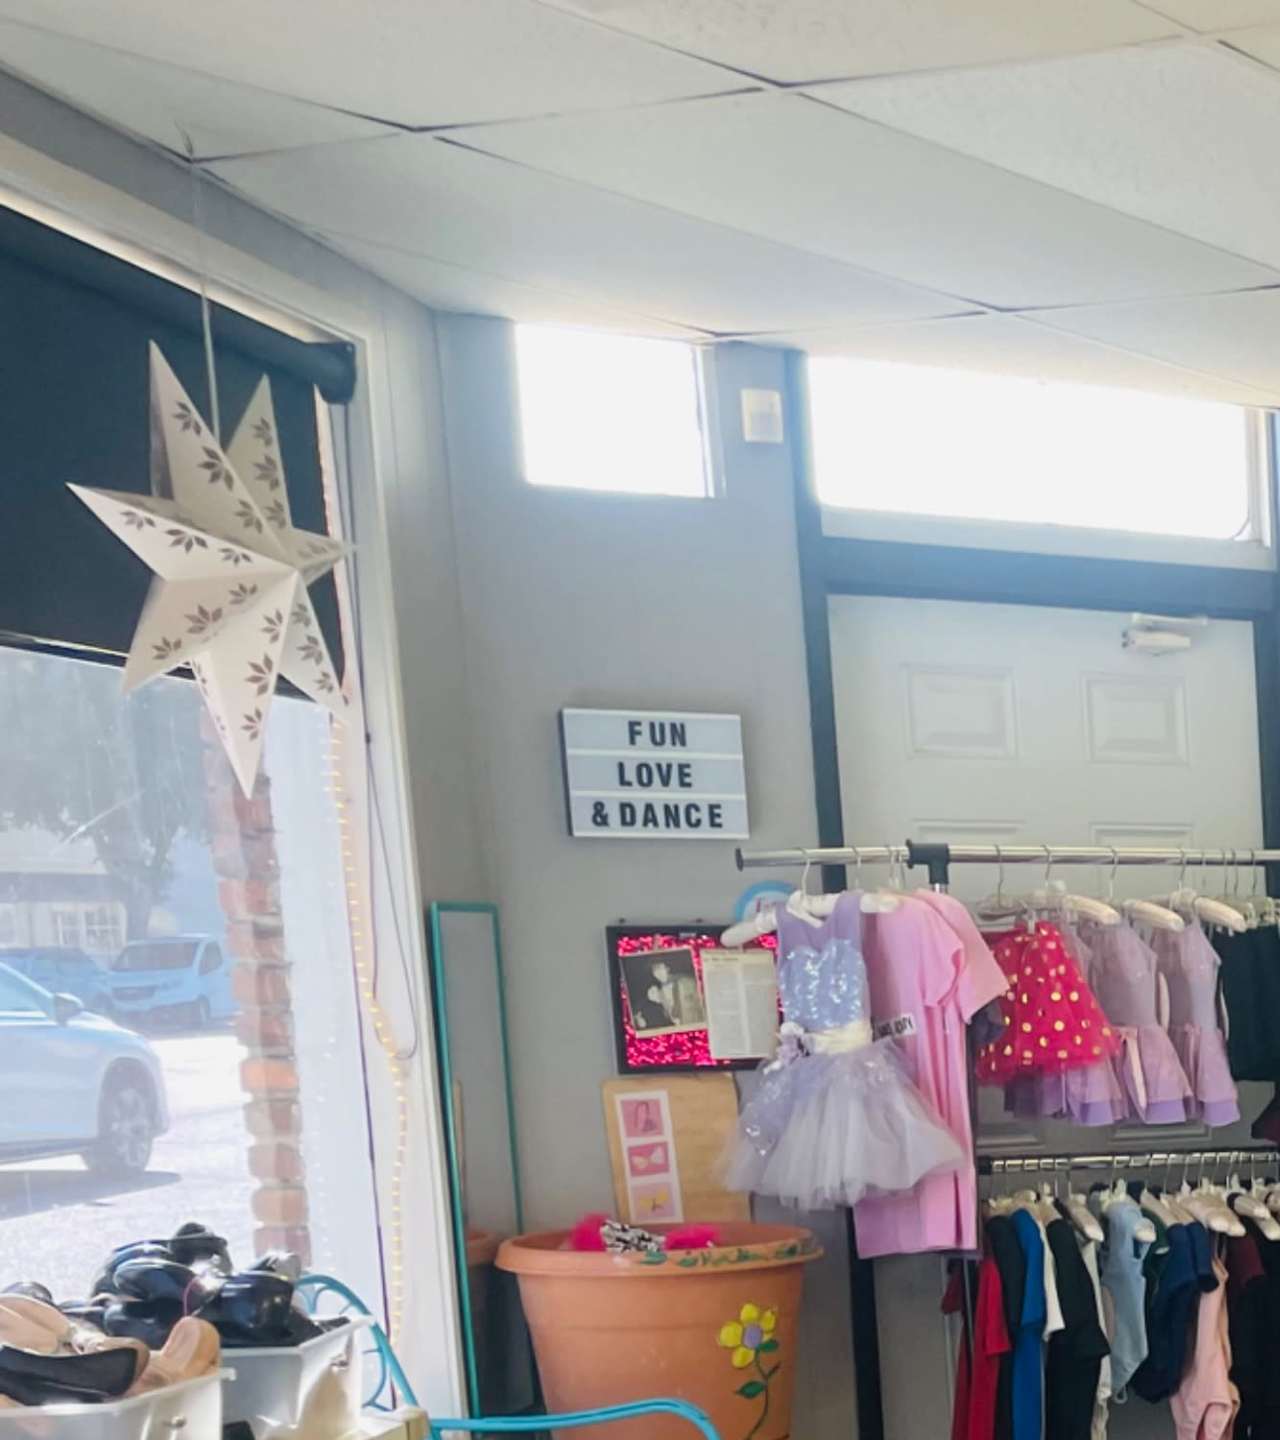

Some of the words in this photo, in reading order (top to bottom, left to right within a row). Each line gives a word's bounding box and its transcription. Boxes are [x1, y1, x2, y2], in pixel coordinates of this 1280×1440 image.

[628, 720, 687, 747] FUN
[617, 761, 693, 788] LOVE
[591, 801, 610, 828] &
[619, 802, 724, 829] DANCE
